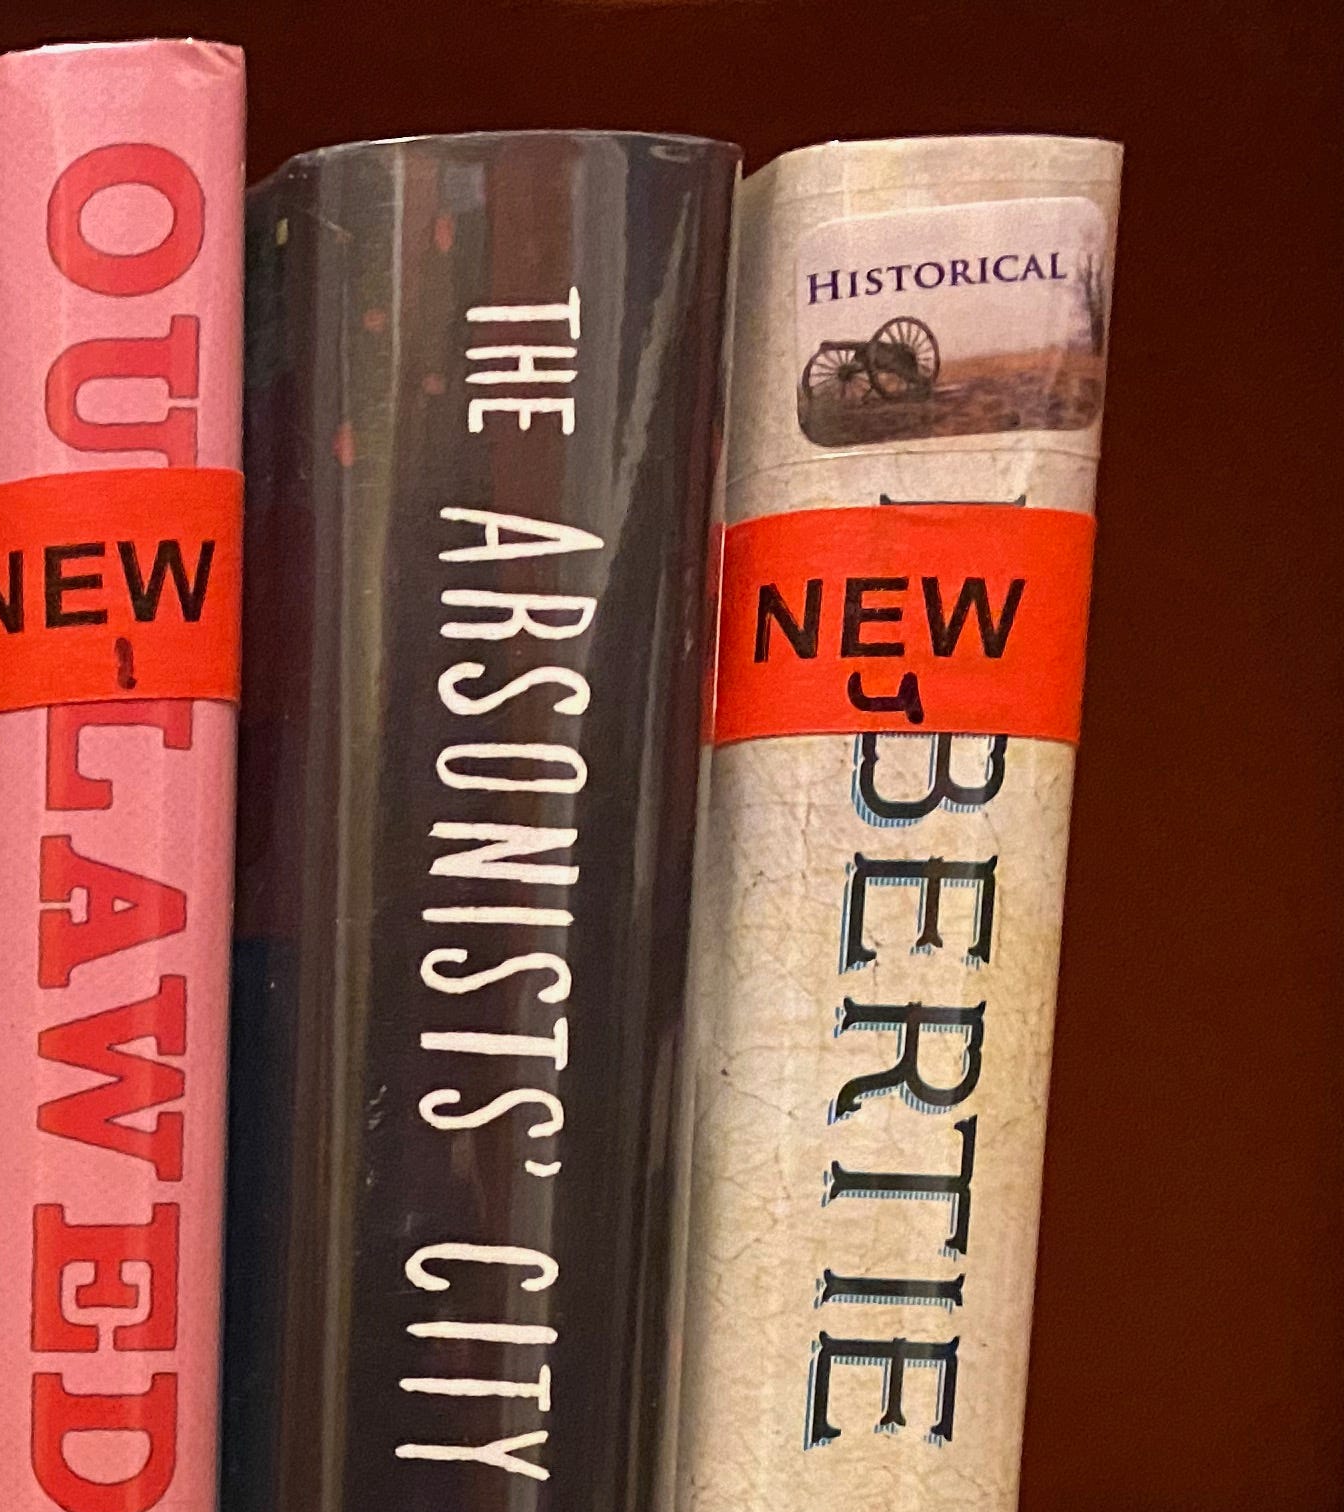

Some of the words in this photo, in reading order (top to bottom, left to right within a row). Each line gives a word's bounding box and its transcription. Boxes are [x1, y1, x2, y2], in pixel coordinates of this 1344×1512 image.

[465, 286, 582, 434] THE
[754, 576, 1025, 663] NEW
[804, 493, 1026, 1451] BERTIE
[394, 1243, 559, 1481] CITY
